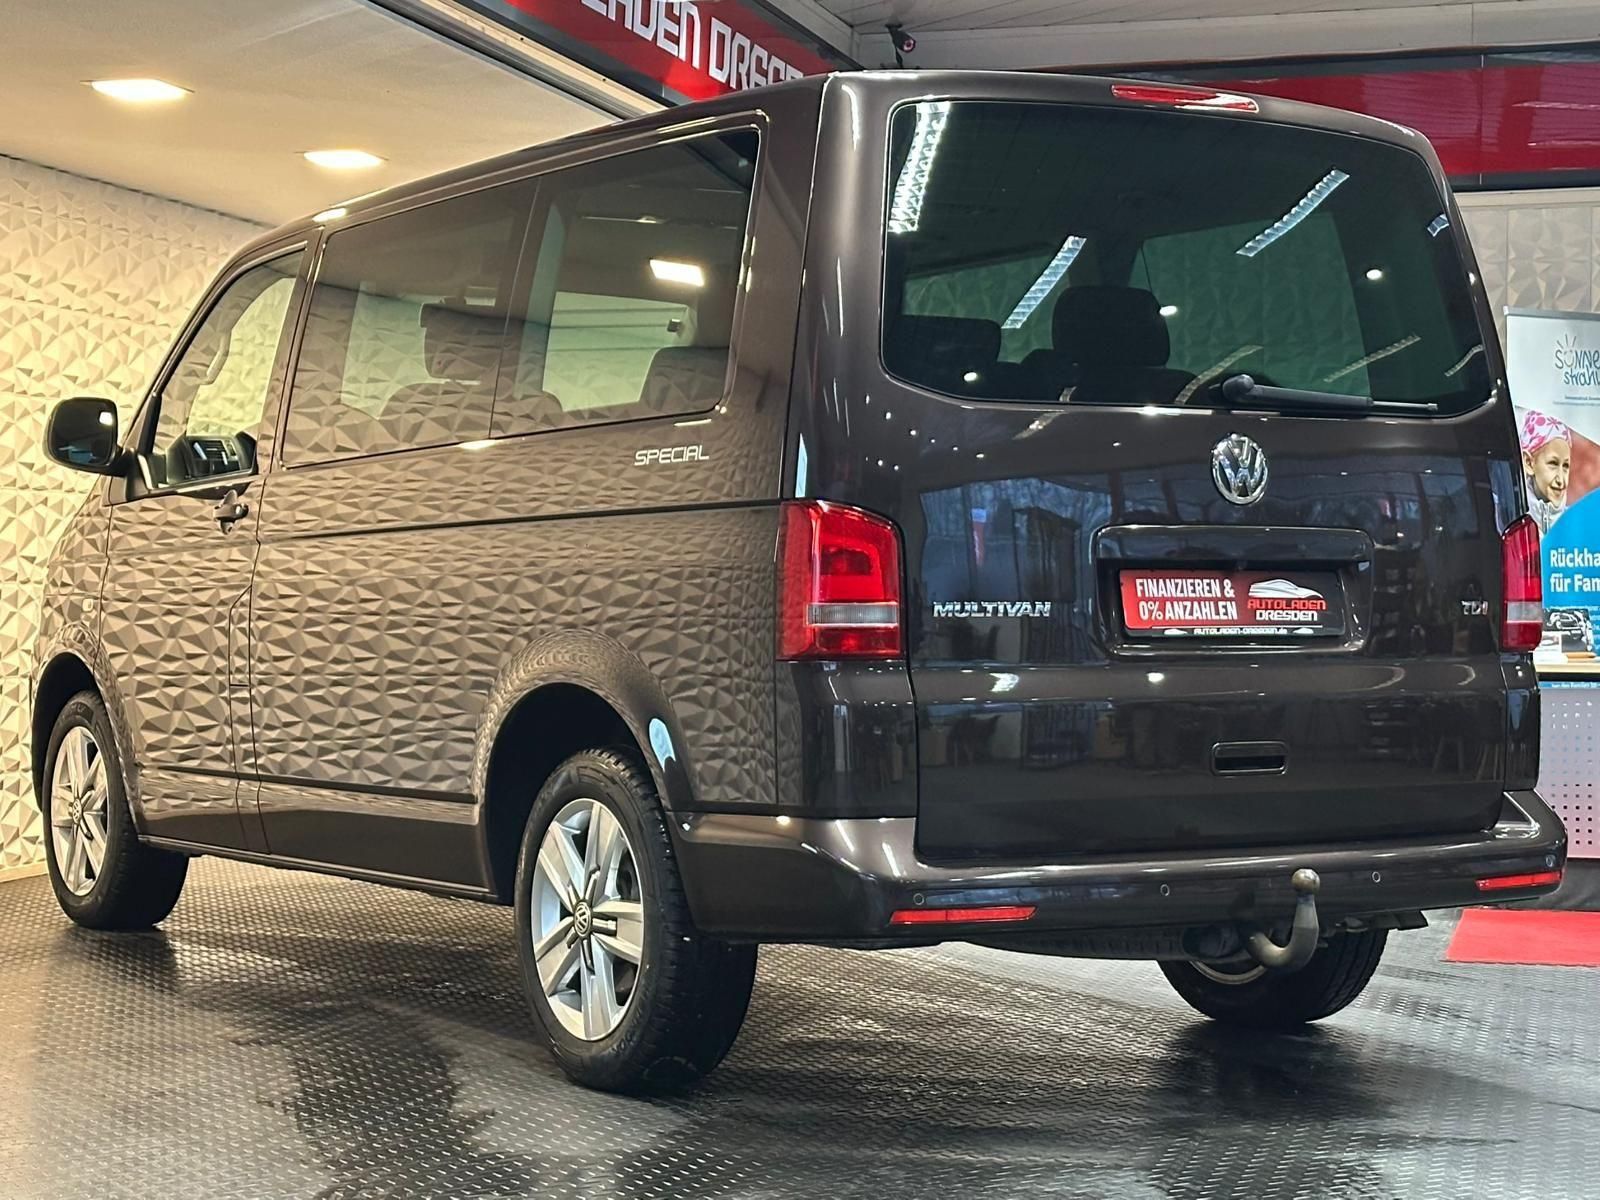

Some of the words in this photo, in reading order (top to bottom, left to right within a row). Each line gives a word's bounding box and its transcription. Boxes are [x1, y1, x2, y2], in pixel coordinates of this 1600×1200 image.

[581, 0, 700, 70] DEN
[634, 445, 710, 466] SPECIAL
[1135, 578, 1221, 598] FINANZIEREN
[1223, 578, 1236, 598] &
[1550, 573, 1571, 593] für
[933, 601, 1052, 618] MULTIVAN
[1138, 600, 1163, 620] 0%
[1165, 601, 1238, 620] ANZAHLEN
[1247, 599, 1327, 610] AUTOLADEN
[1255, 609, 1318, 622] DRESDEN
